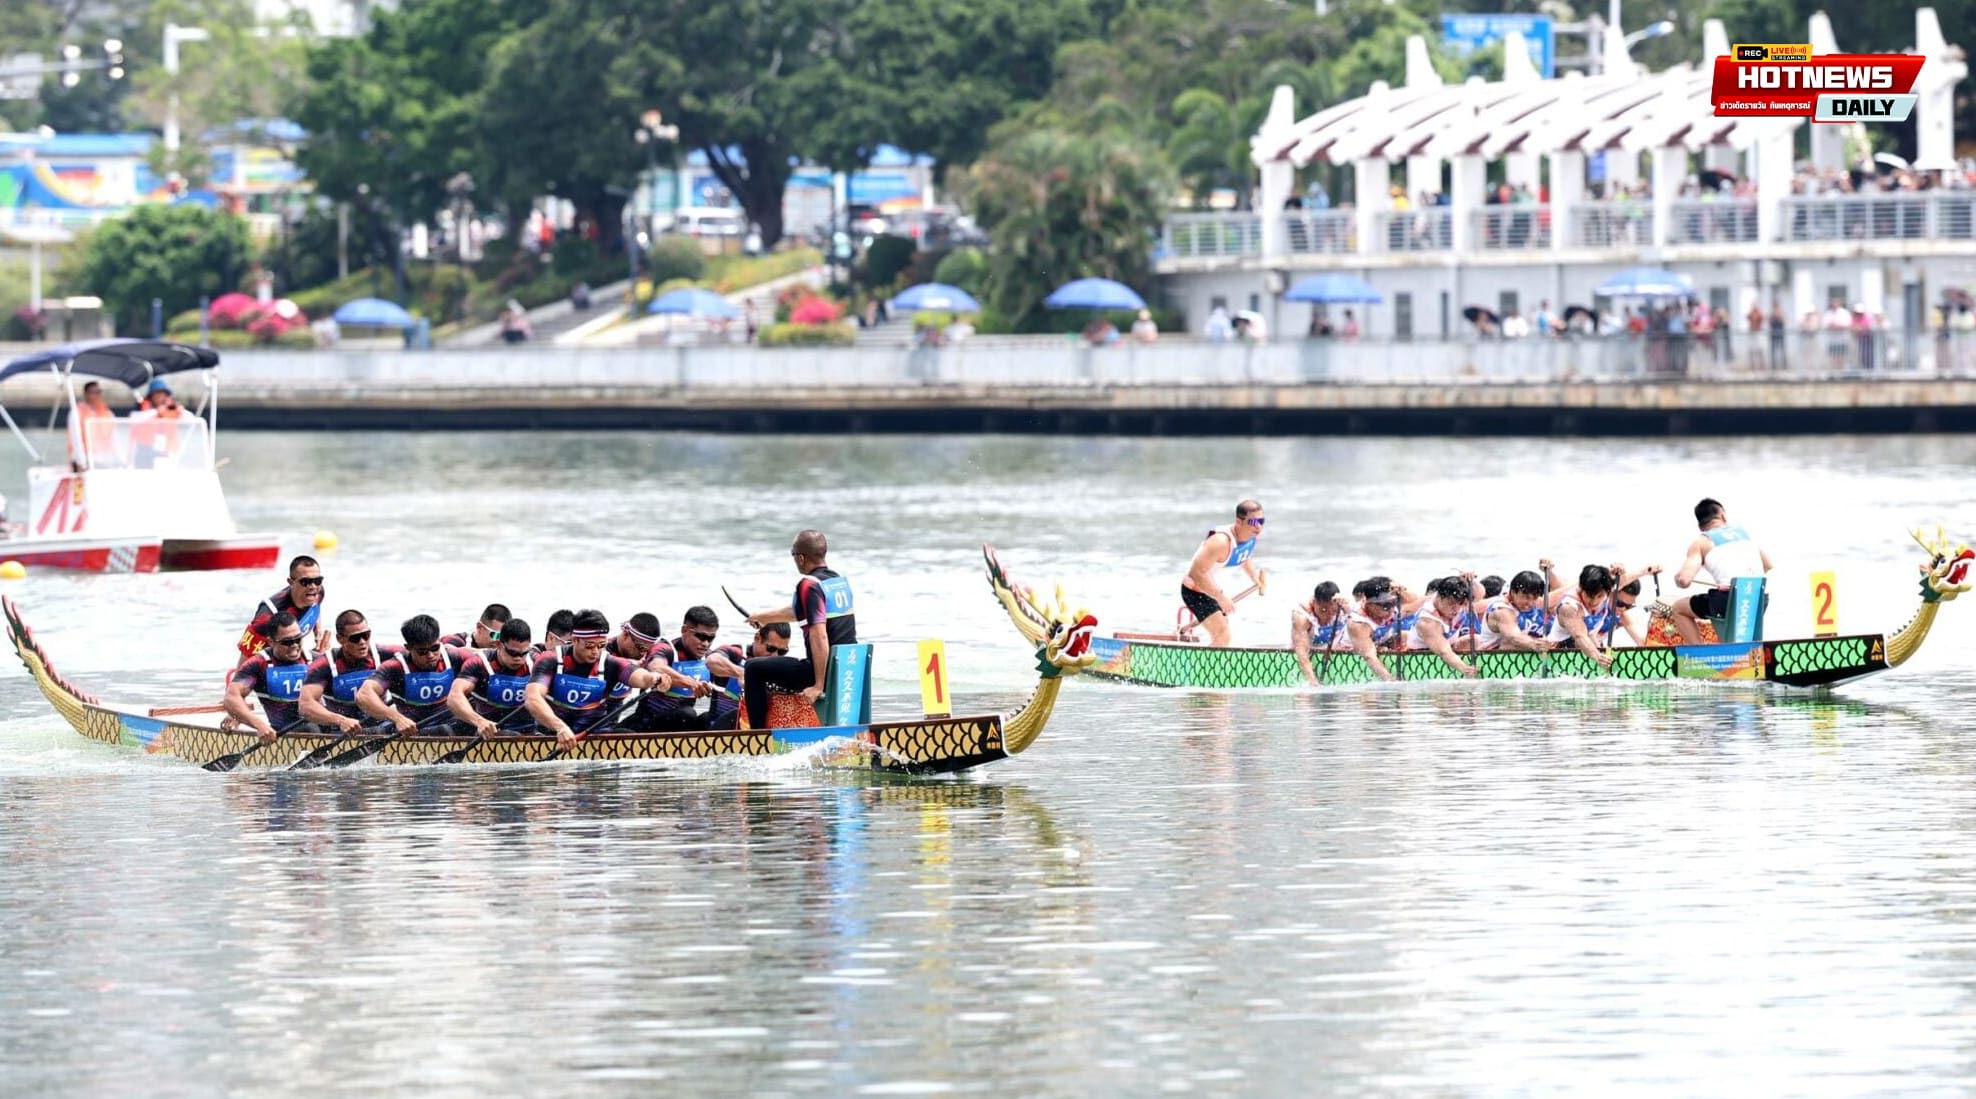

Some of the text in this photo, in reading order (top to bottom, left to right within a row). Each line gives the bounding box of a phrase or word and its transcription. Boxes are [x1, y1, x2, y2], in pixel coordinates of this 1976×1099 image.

[835, 591, 849, 608] 01
[1815, 582, 1834, 625] 2
[926, 652, 943, 704] 1
[282, 679, 304, 695] 14
[420, 685, 444, 700] 09
[502, 688, 526, 702] 08
[567, 689, 591, 703] 07
